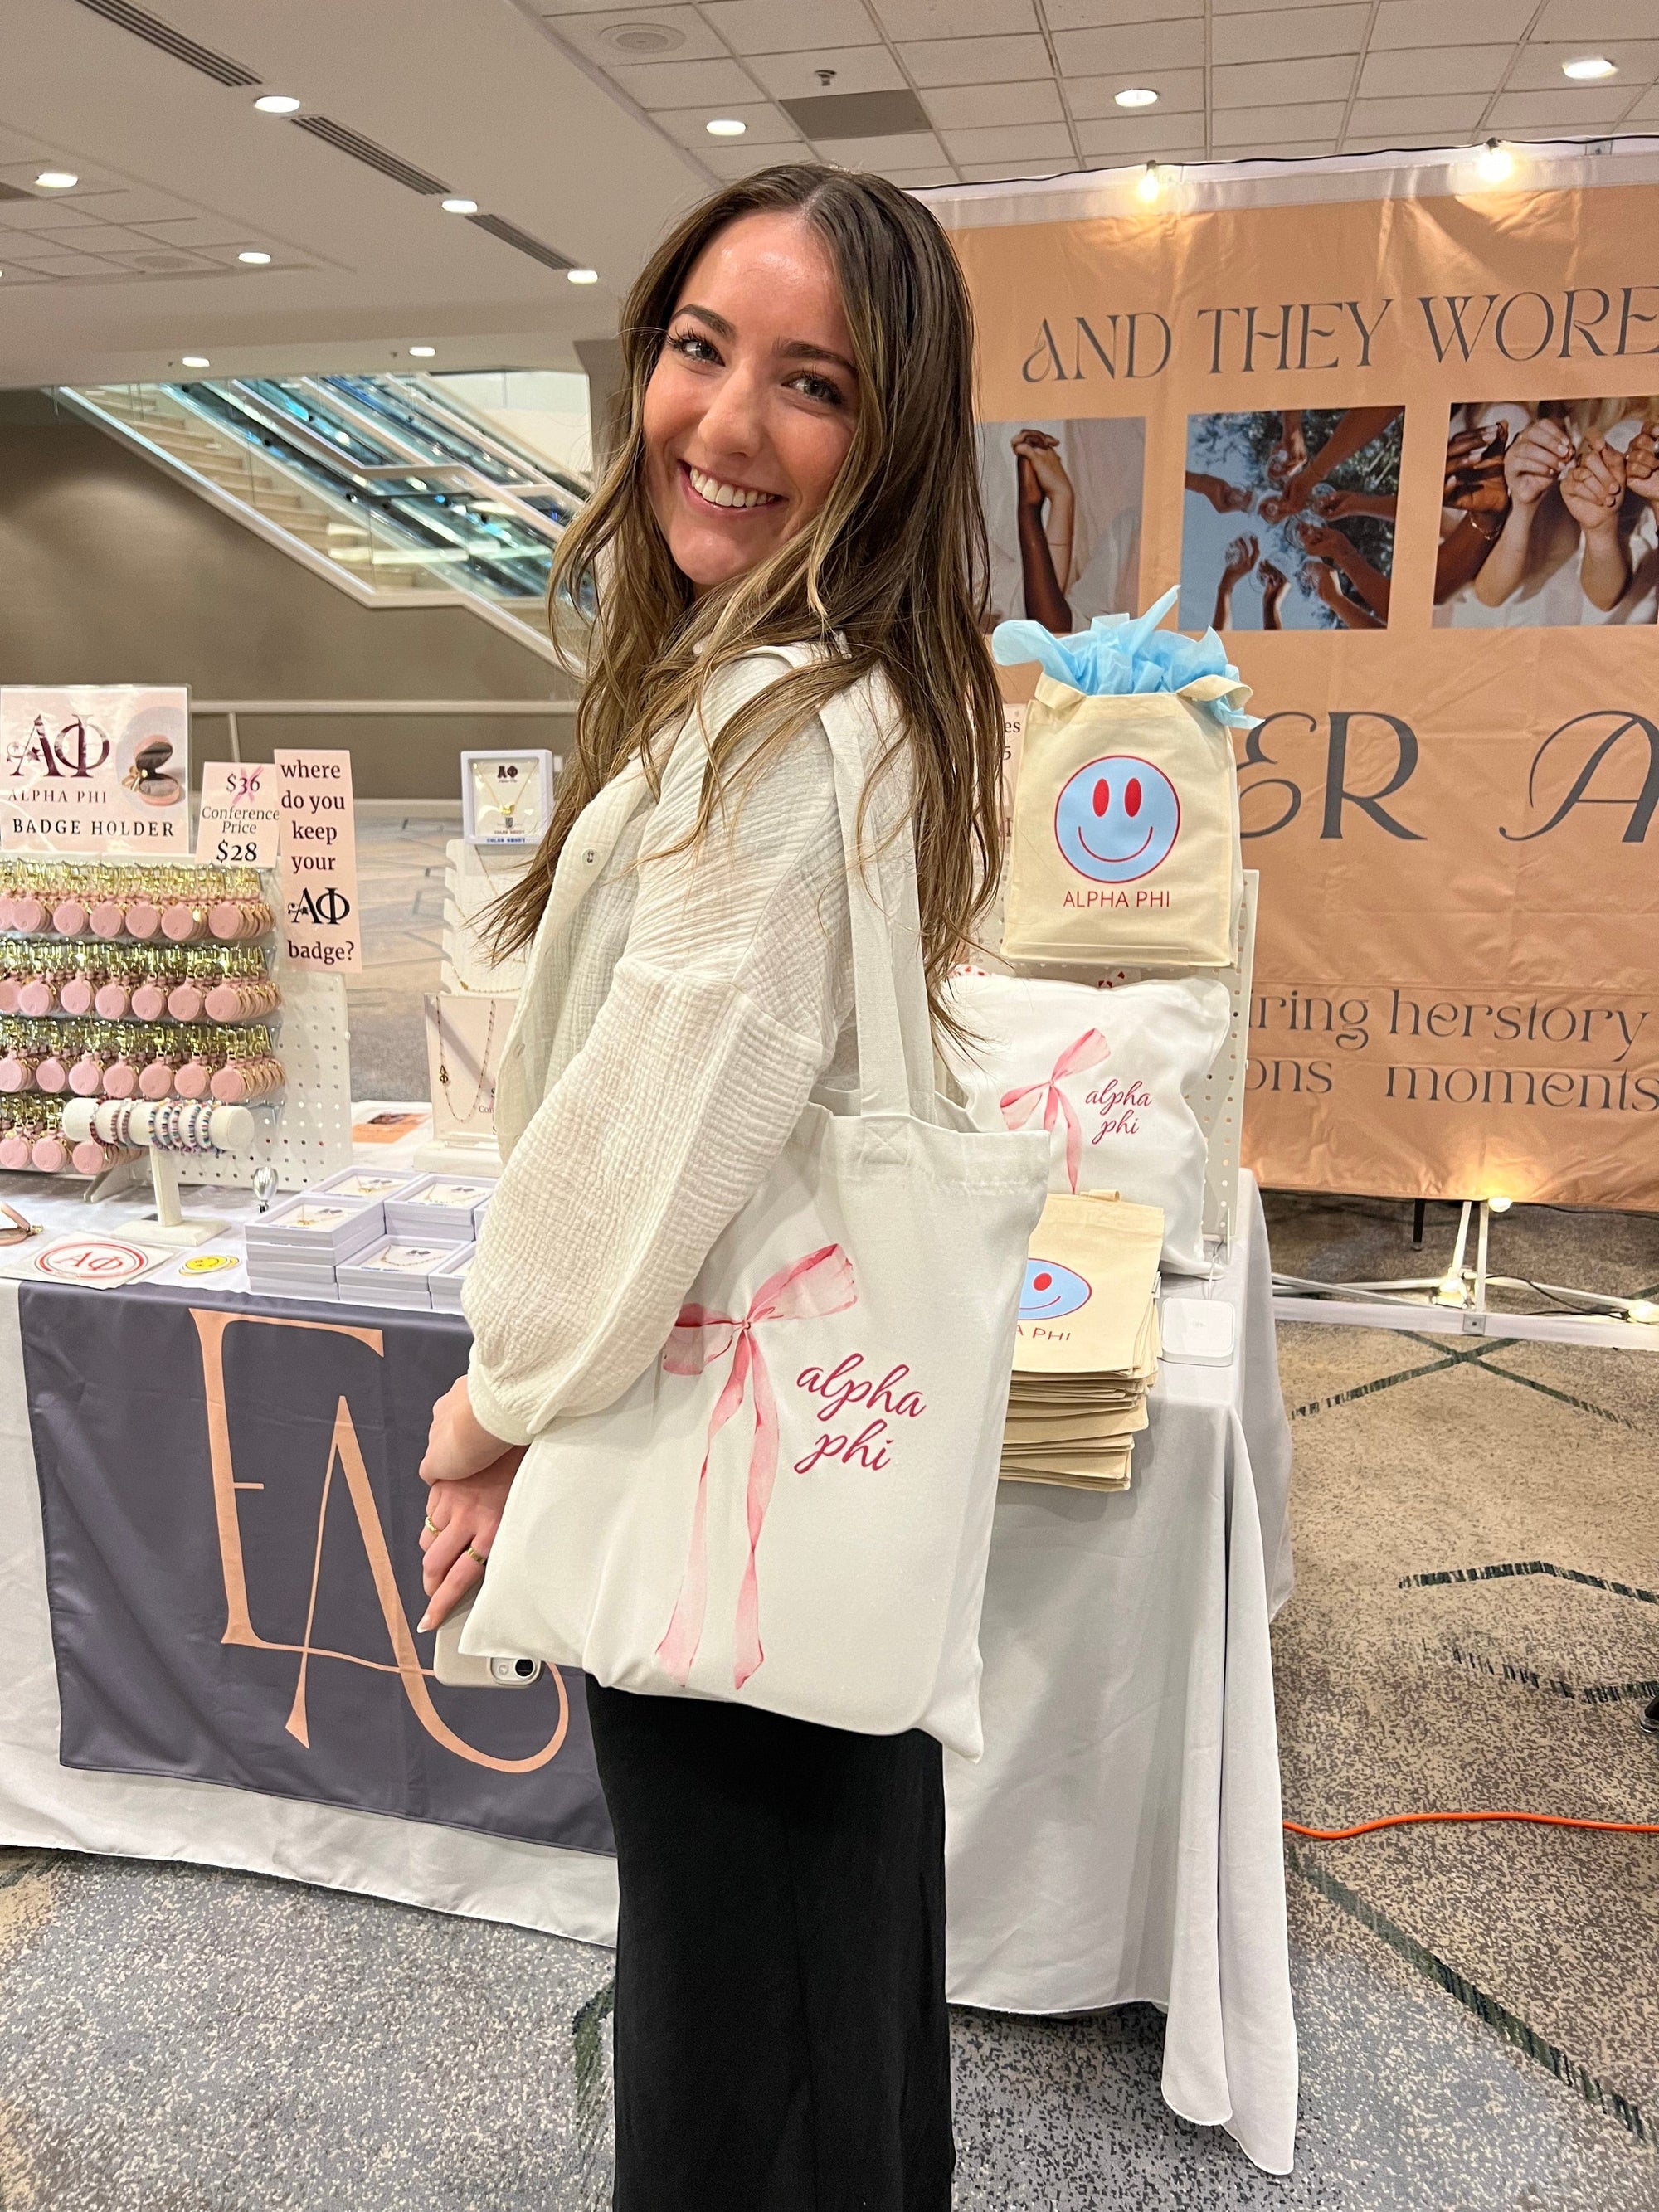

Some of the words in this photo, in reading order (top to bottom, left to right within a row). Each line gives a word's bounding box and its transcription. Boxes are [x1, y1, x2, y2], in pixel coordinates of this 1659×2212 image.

[1022, 311, 1172, 383] AND
[1196, 299, 1394, 374] THEY
[1416, 286, 1659, 363] WORE
[280, 759, 341, 779] where
[1237, 712, 1428, 841] ER
[226, 773, 260, 795] $36
[8, 790, 68, 803] ALPHA
[77, 790, 107, 804] PHI
[281, 790, 304, 809] do
[309, 796, 345, 814] you
[202, 806, 280, 820] Conference
[13, 819, 81, 834] BADGE
[91, 821, 174, 837] HOLDER
[221, 820, 257, 834] Price
[292, 820, 338, 845] keep
[216, 839, 257, 863] $28
[291, 856, 336, 874] your
[1063, 890, 1130, 908] ALPHA
[1136, 890, 1170, 908] PHI
[287, 940, 355, 965] badge?
[1388, 989, 1649, 1062] herstory
[1245, 1057, 1332, 1094] ons
[1385, 1067, 1659, 1112] moments
[1085, 1079, 1153, 1116] alpha
[1091, 1109, 1140, 1145] phi
[1032, 1327, 1071, 1341] PHI
[796, 1352, 927, 1422] alpha
[793, 1418, 894, 1474] phi
